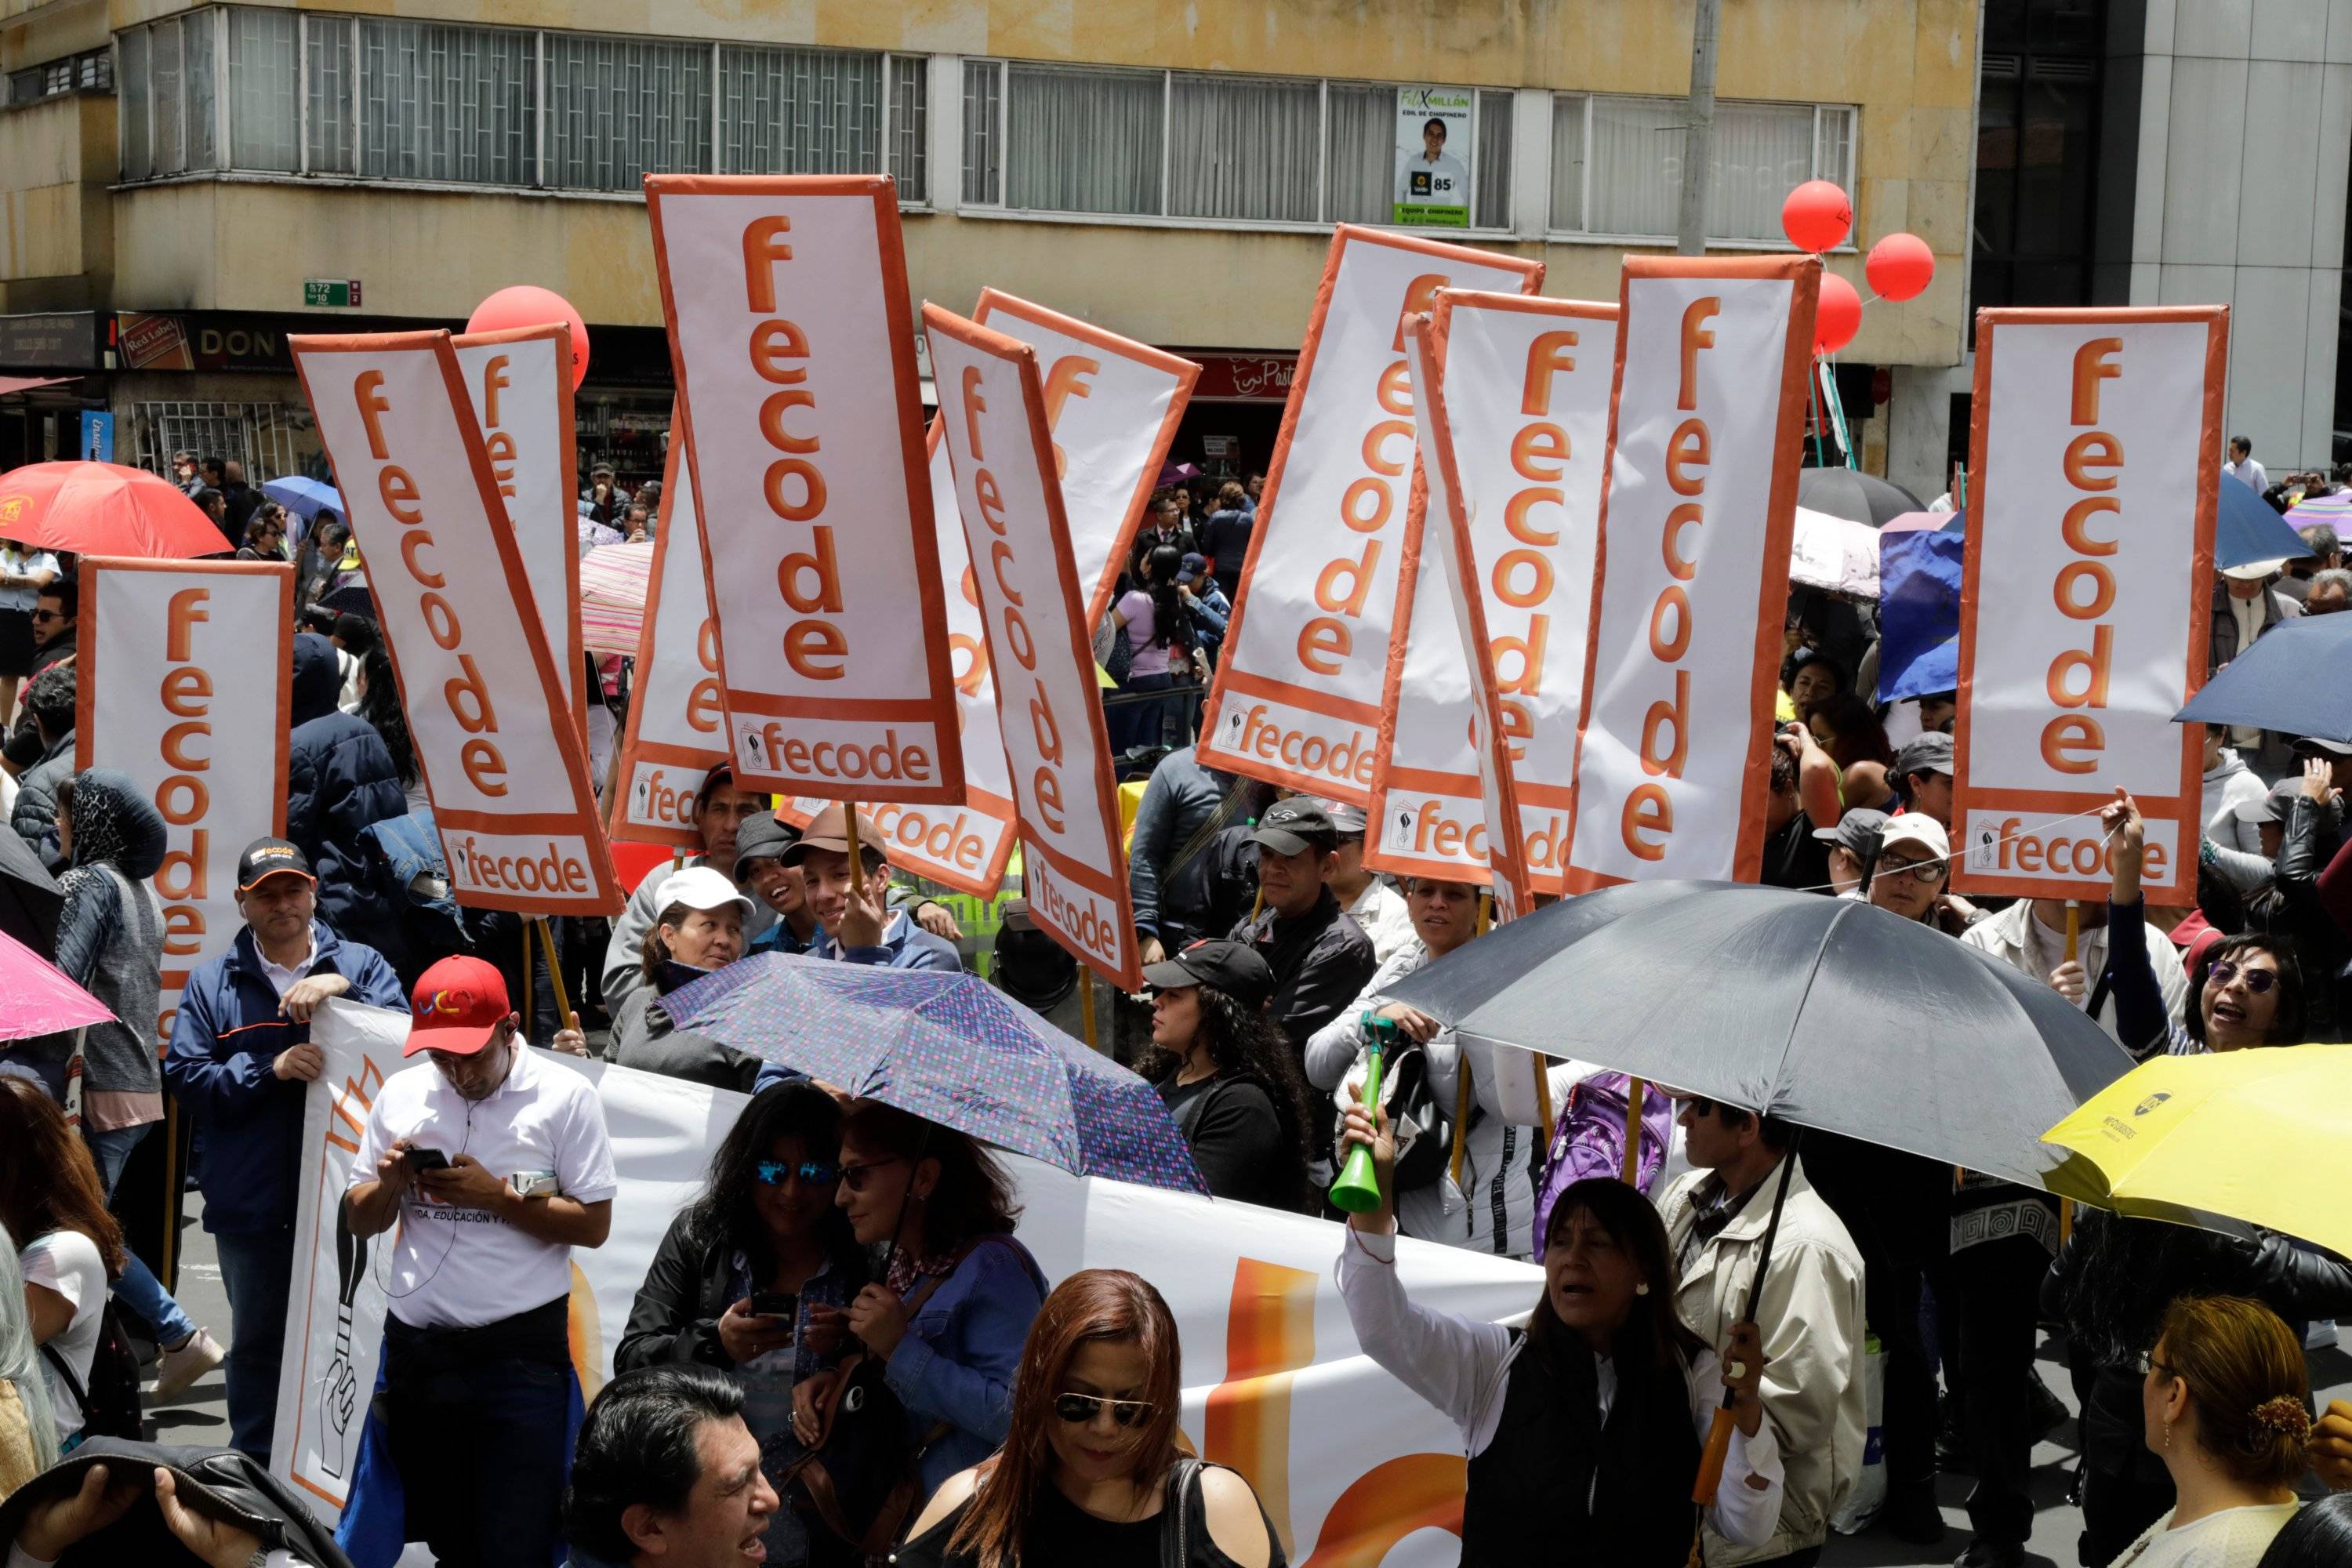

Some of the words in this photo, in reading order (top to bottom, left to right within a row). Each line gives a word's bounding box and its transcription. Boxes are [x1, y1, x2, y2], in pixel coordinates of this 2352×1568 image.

[1434, 179, 1451, 191] 85
[317, 284, 330, 293] 72
[201, 329, 274, 357] DON
[742, 216, 848, 681] fecode
[1297, 274, 1450, 676] fecode
[354, 370, 508, 797] fecode
[962, 365, 1065, 833] fecode
[1621, 296, 1721, 861] fecode
[2040, 337, 2125, 774] fecode
[154, 588, 213, 956] fecode
[763, 723, 931, 781] fecode
[1240, 705, 1377, 785] fecode
[466, 837, 588, 892] fecode
[1039, 861, 1116, 960] fecode
[434, 1210, 490, 1223] EDUCACIÓN
